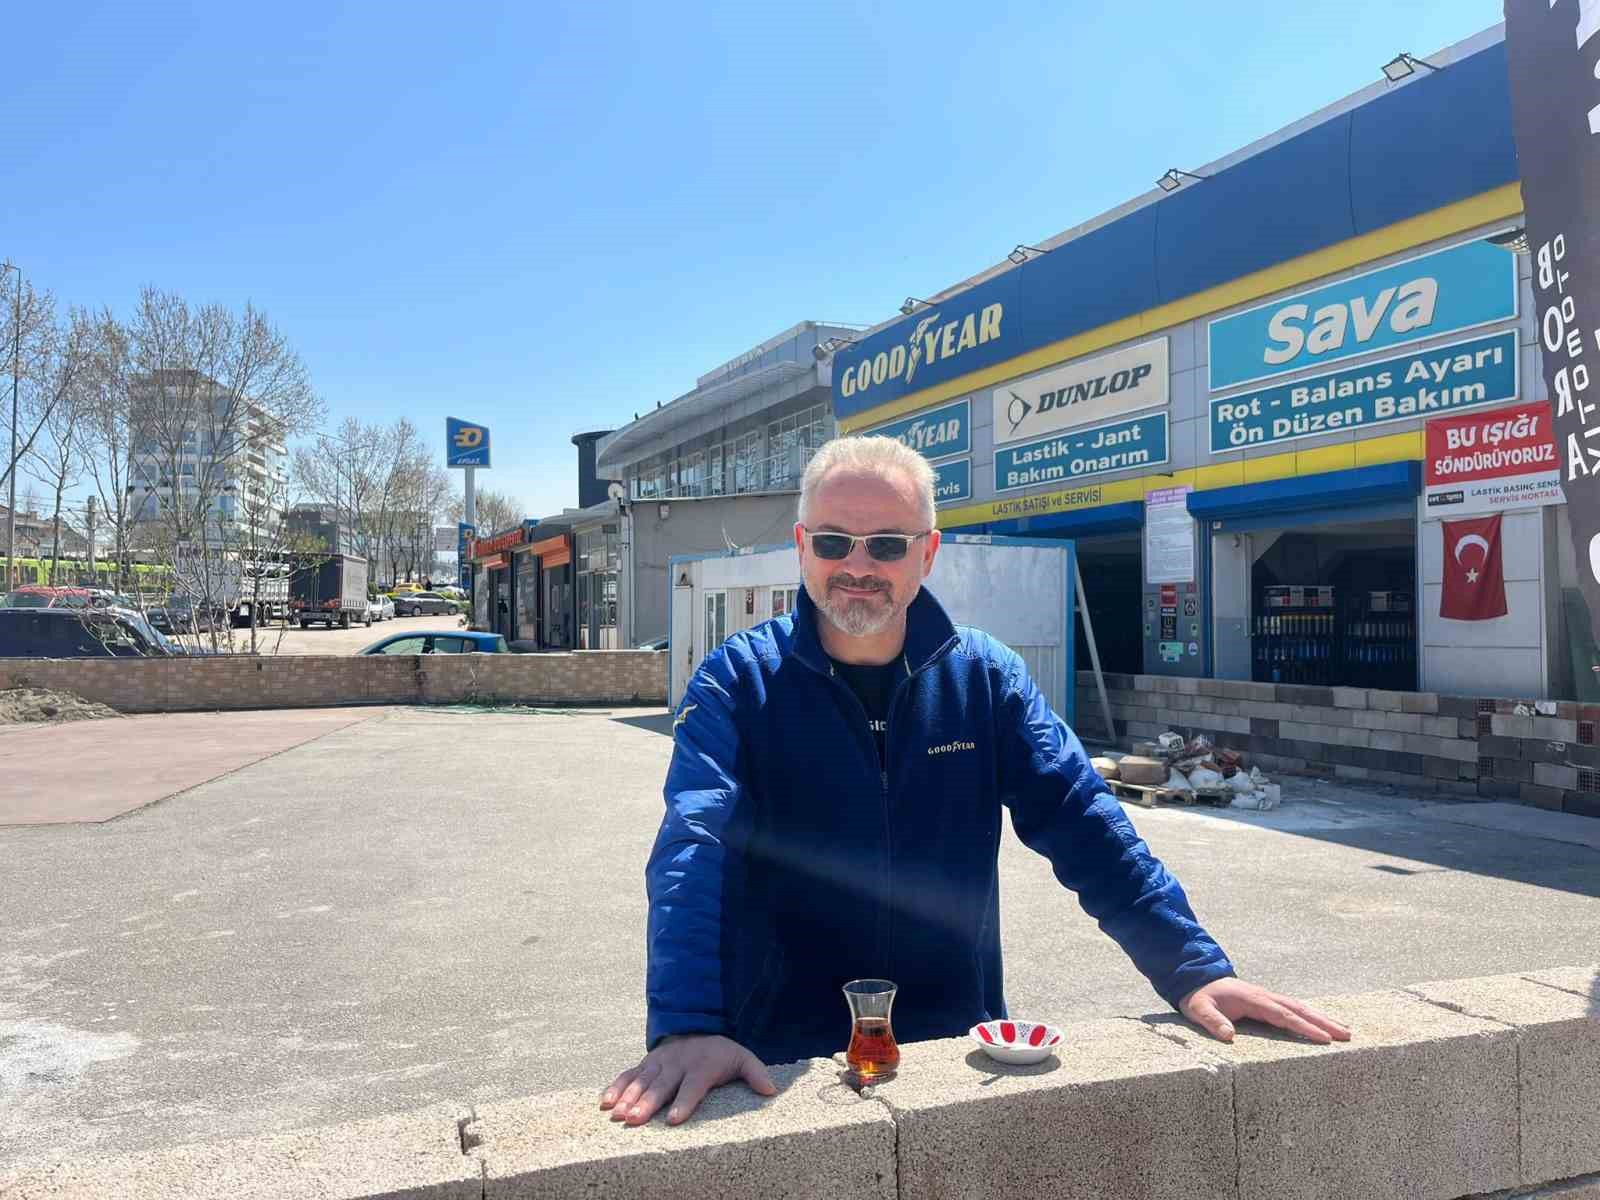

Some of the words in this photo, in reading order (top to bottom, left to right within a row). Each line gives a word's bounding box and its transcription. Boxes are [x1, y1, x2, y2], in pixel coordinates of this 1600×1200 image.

[1263, 276, 1438, 365] Sava
[1035, 363, 1152, 415] DUNLOP
[1216, 399, 1261, 424] Rot
[1291, 369, 1393, 408] Balans
[1405, 346, 1503, 383] Ayarı
[1229, 422, 1264, 446] Ön
[1273, 409, 1363, 438] Düzen
[1375, 380, 1486, 419] Bakım
[1446, 426, 1477, 450] BU
[1482, 412, 1538, 446] IŞIĞI
[1012, 442, 1070, 466] Lastik
[1091, 425, 1142, 448] Jant
[1435, 443, 1555, 476] SÖNDÜRÜYORUZ
[1007, 464, 1064, 487] Bakım
[1070, 449, 1149, 475] Onarım
[927, 740, 976, 755] GOODYEAR
